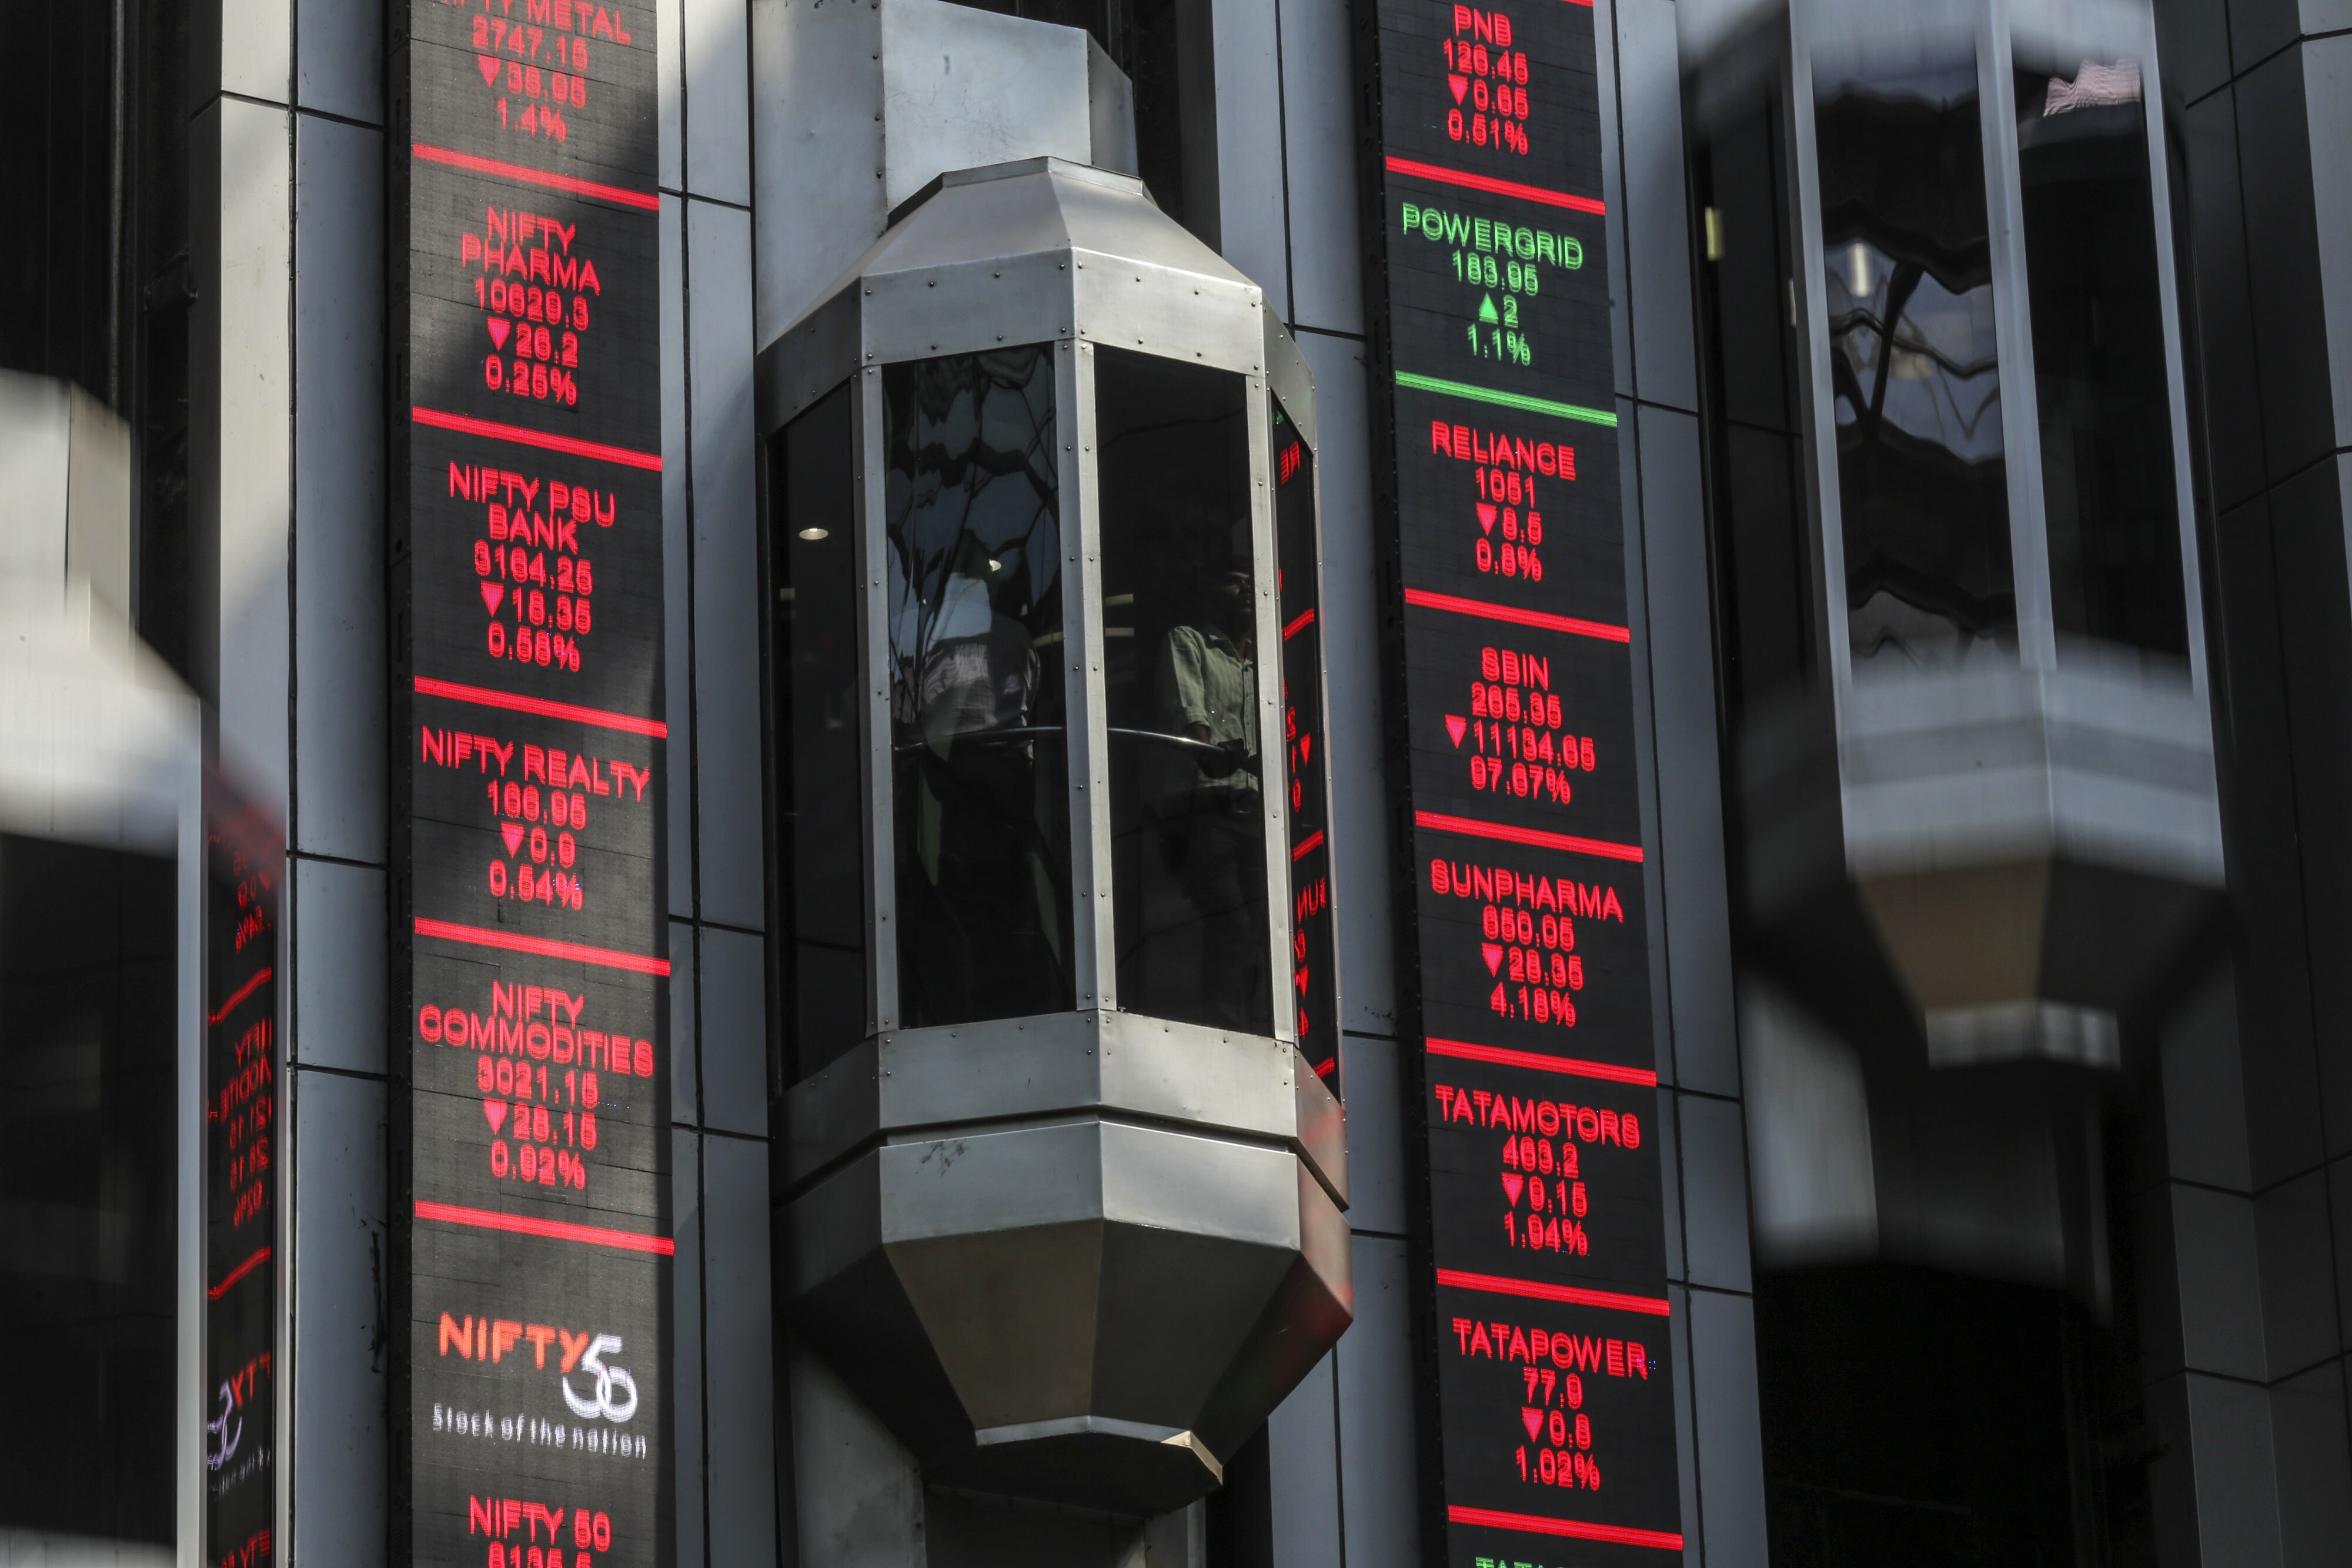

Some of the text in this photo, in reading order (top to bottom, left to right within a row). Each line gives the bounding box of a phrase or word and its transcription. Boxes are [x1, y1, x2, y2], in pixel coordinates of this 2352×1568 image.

[473, 15, 589, 71] 2747.15
[1454, 4, 1512, 46] PNB
[497, 97, 567, 142] 1.4%
[1448, 108, 1528, 155] 0.51%
[485, 206, 576, 254] NIFTY
[1403, 203, 1583, 269] POWERGRID
[461, 233, 600, 296] PHARMA
[1504, 295, 1518, 327] 2
[1468, 325, 1531, 365] 1.1%
[485, 355, 577, 405] 0.25%
[1432, 421, 1576, 480] RELIANCE
[449, 461, 616, 527] NIFTY PSU
[1476, 467, 1535, 508] 1051
[489, 503, 581, 554] BANK
[1482, 647, 1549, 691] SBIN
[422, 726, 650, 801] NIFTY REALTY
[1431, 859, 1623, 922] SUNPHARMA
[492, 981, 584, 1028] NIFTY
[419, 1005, 654, 1077] COMMODITIES
[1435, 1085, 1641, 1149] TATAMOTORS
[1453, 1318, 1648, 1380] TATAPOWER
[502, 1413, 524, 1442] of
[531, 1417, 565, 1448] the
[573, 1425, 646, 1459] nation
[1516, 1446, 1601, 1490] 1.02%
[469, 1495, 612, 1552] NIFTY 50
